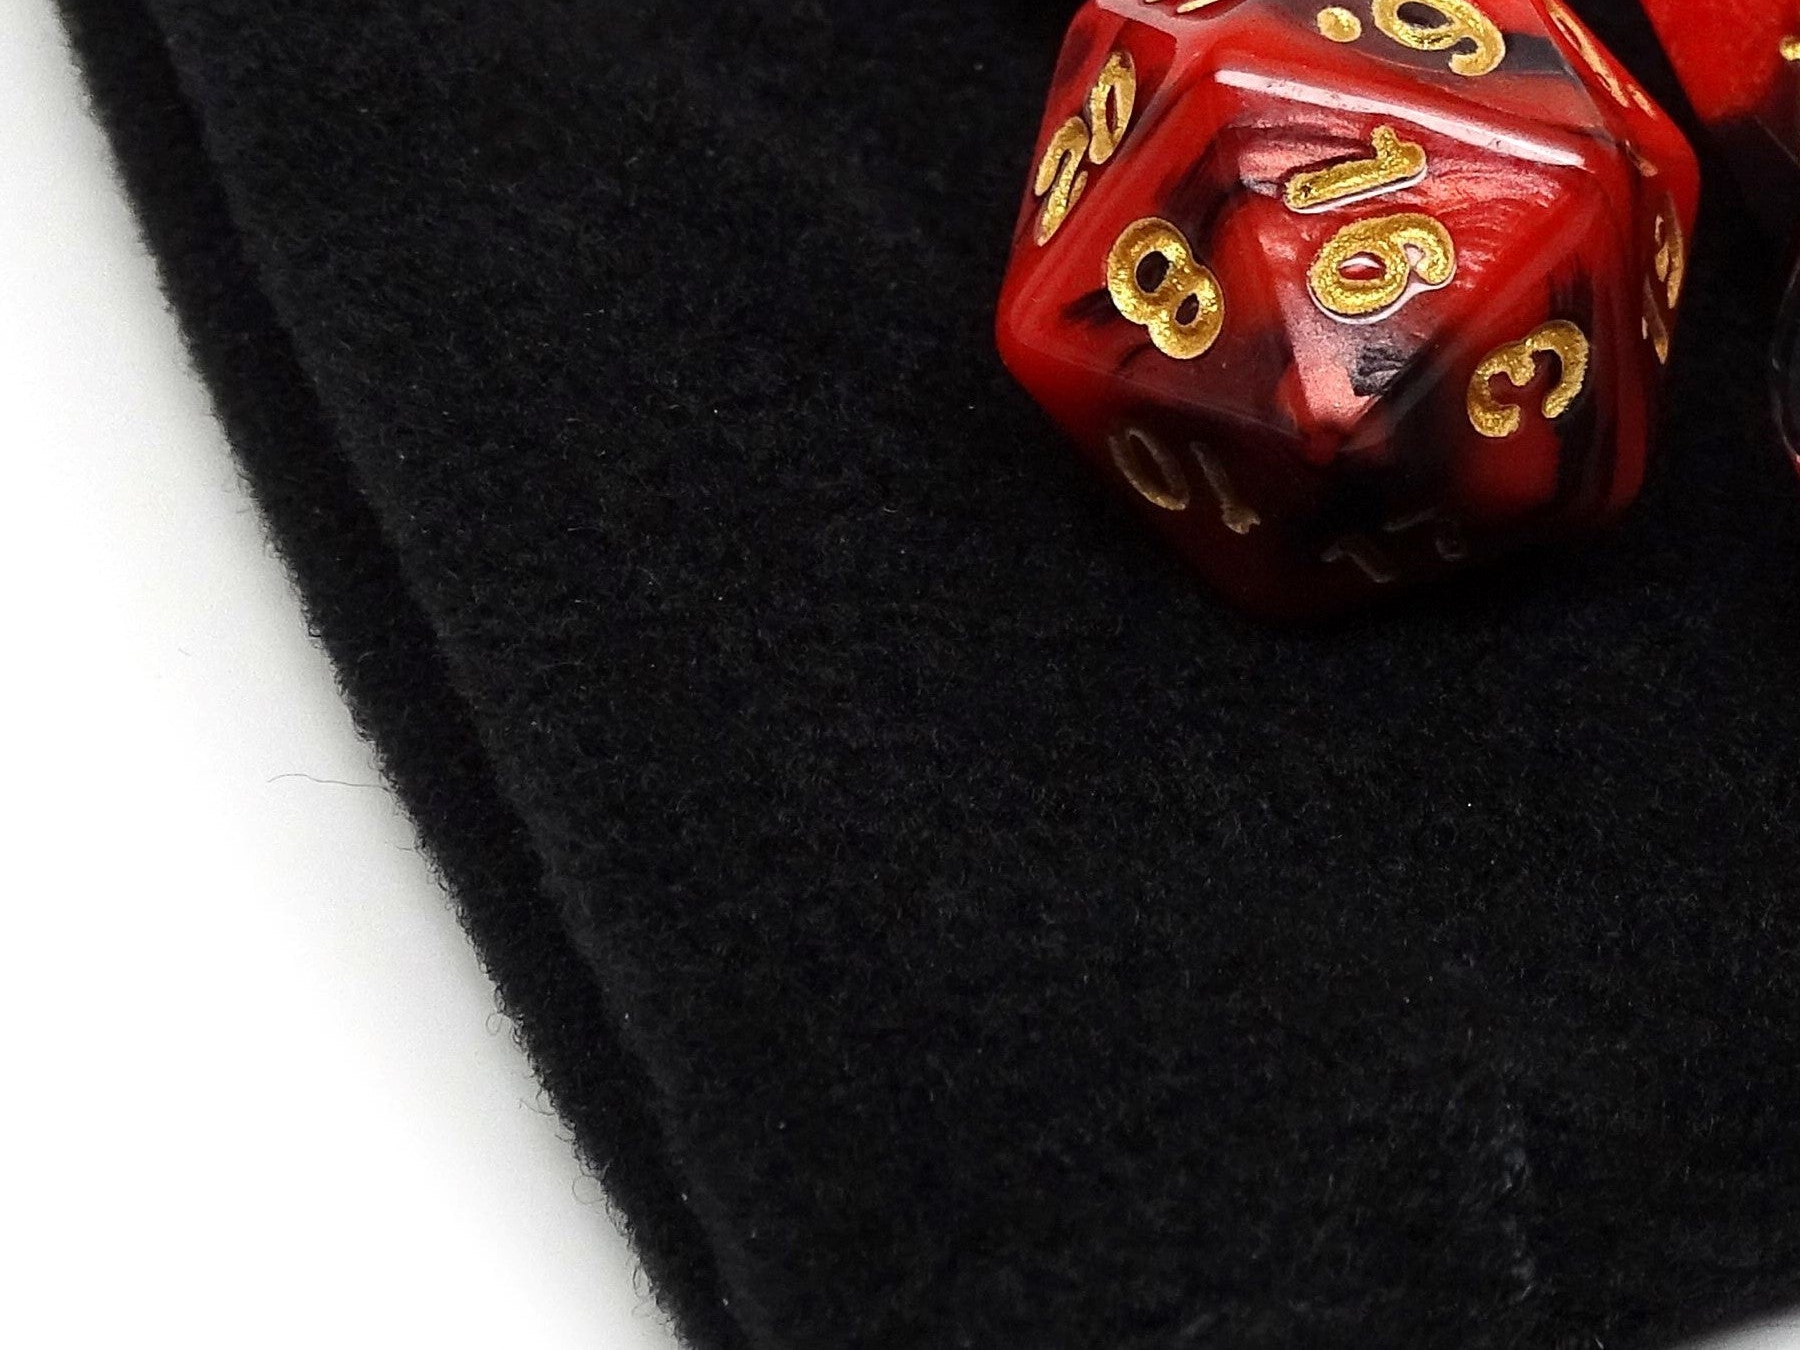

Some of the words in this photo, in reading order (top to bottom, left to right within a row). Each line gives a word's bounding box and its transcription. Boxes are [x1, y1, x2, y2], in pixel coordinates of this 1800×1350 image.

[1033, 50, 1137, 247] 20
[1282, 124, 1458, 324] 16
[1106, 215, 1226, 361] 8
[1466, 319, 1590, 439] 3
